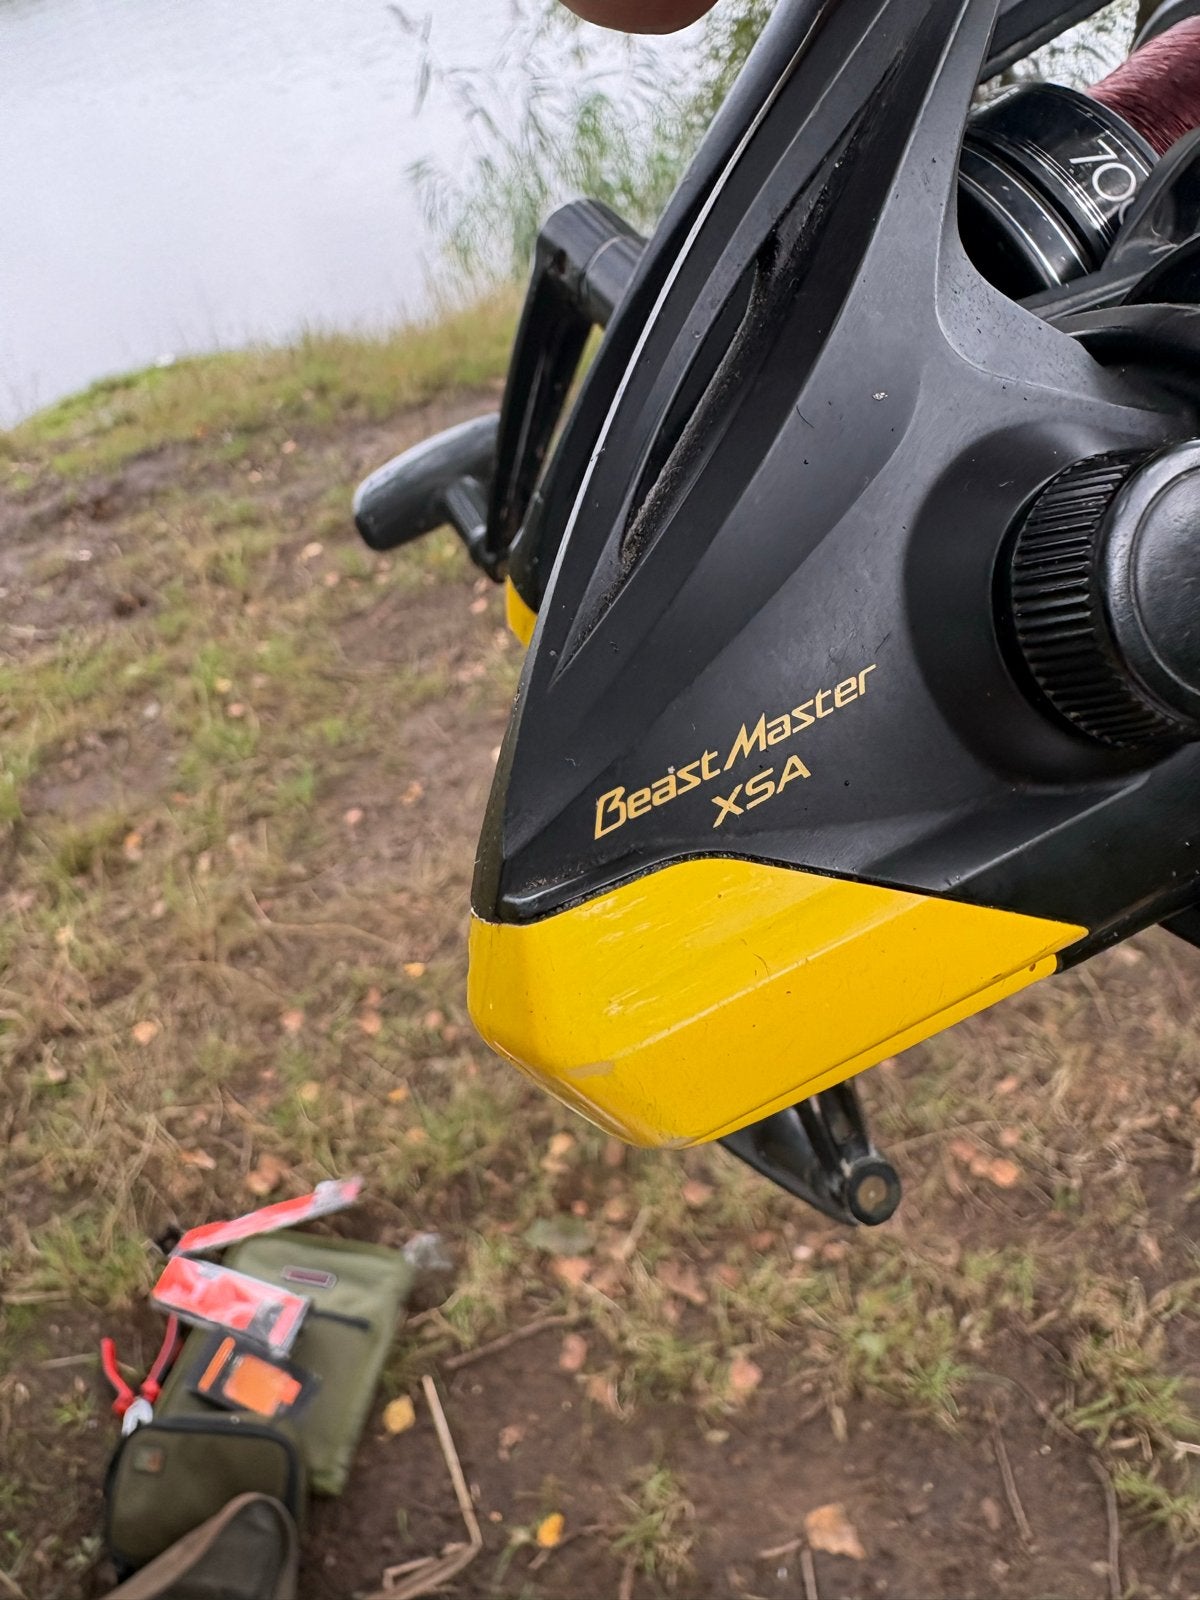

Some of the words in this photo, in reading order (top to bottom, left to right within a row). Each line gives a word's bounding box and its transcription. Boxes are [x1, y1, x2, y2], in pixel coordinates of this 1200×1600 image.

[594, 750, 721, 840] Beast
[723, 664, 877, 771] Master
[711, 755, 811, 828] XSA
